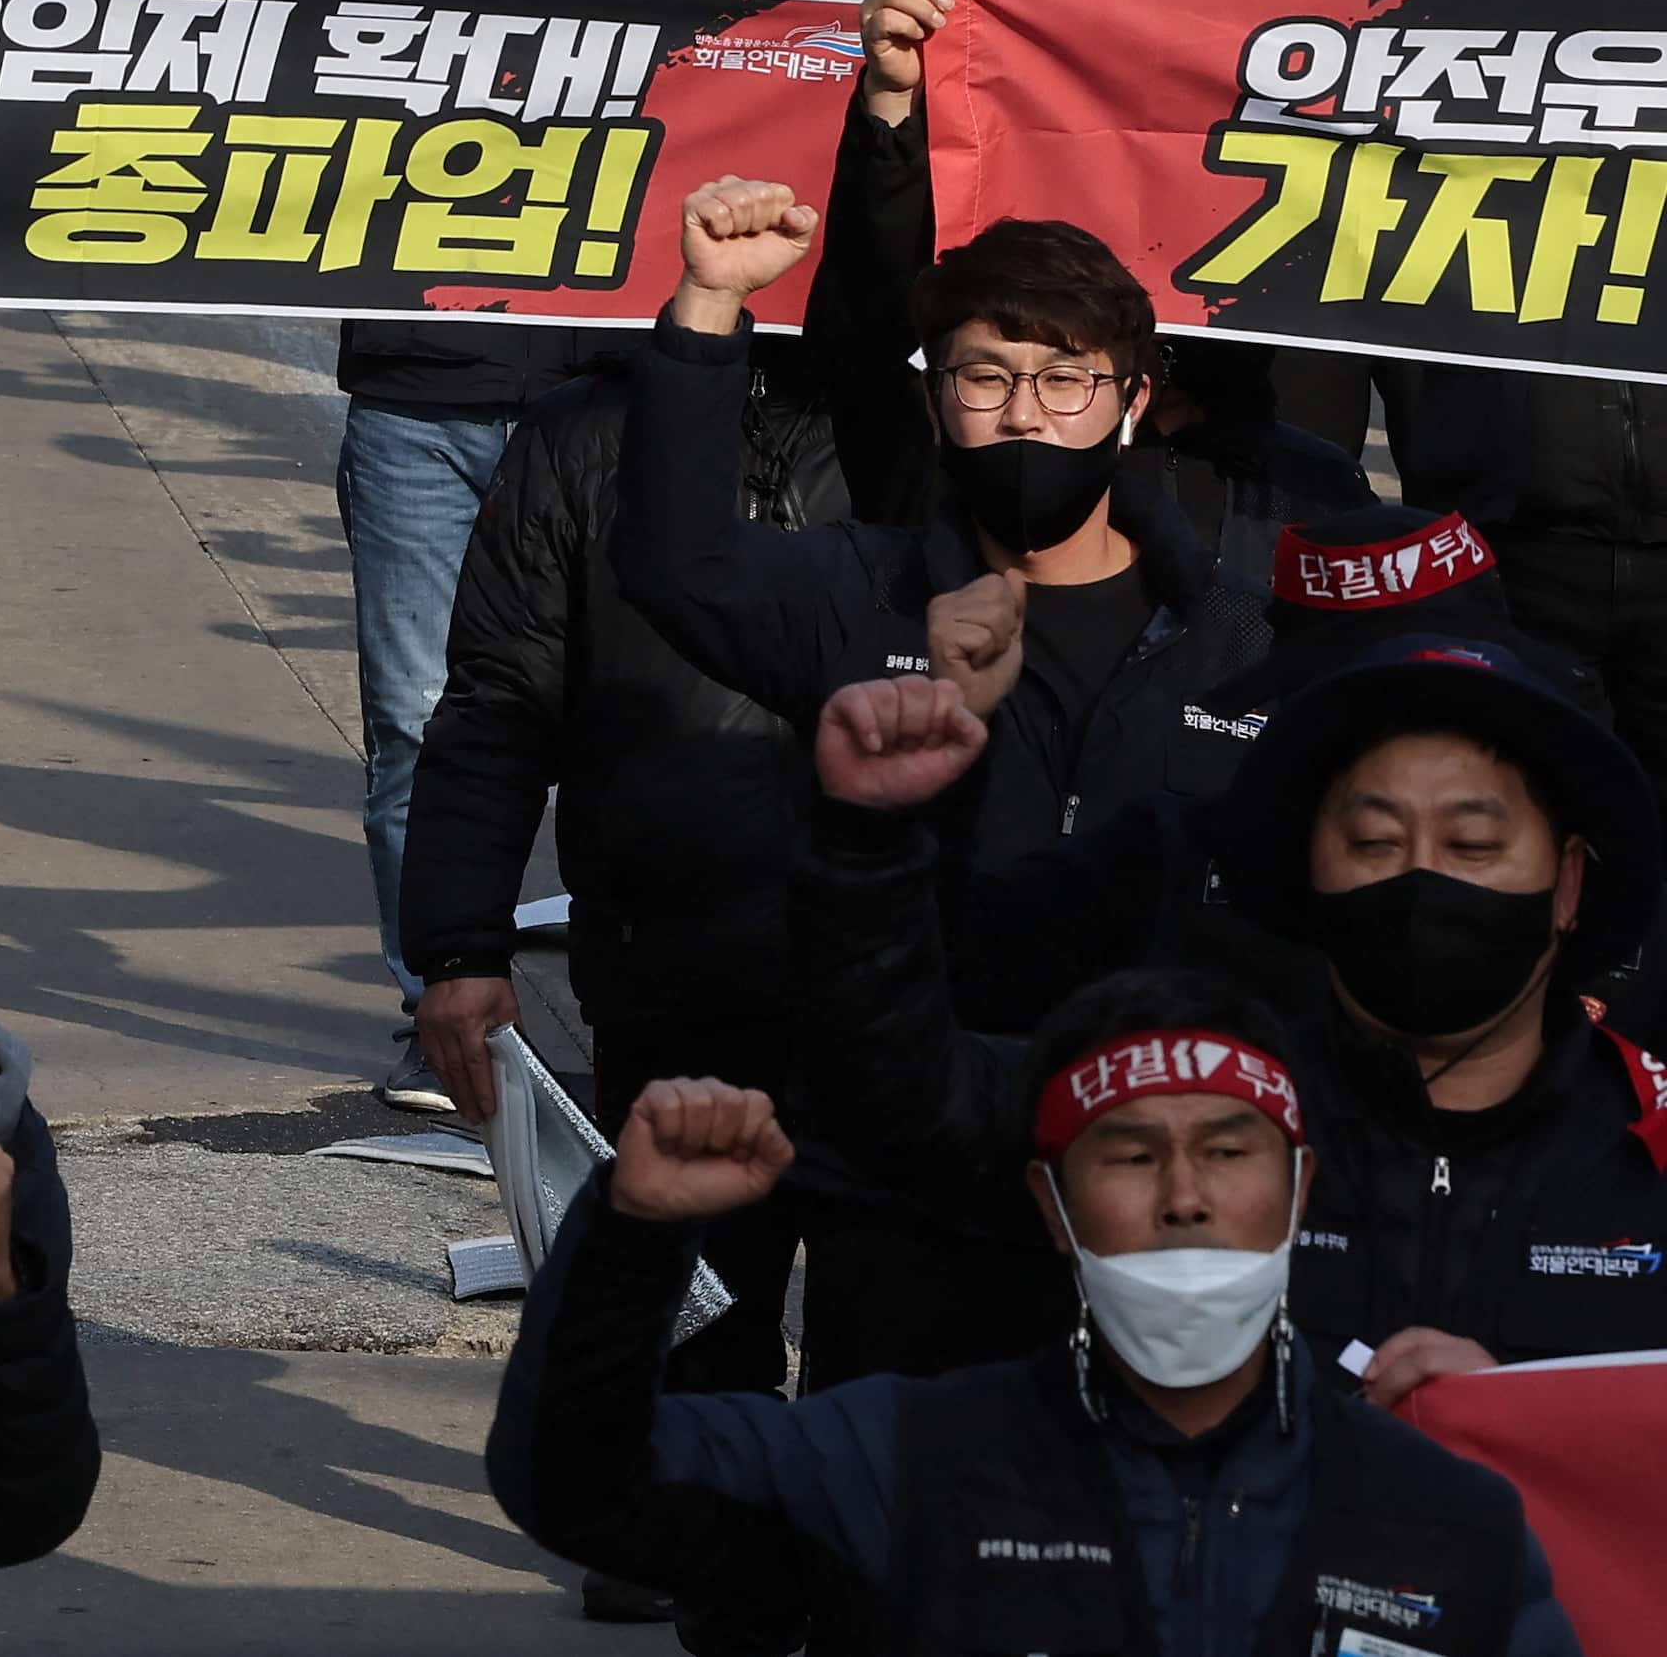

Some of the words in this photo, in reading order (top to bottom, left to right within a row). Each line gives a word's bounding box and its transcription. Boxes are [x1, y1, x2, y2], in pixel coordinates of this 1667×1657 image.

[315, 2, 660, 126] 확대!
[693, 46, 854, 82] 화물연대본부
[25, 103, 649, 279] 총파업!
[1189, 131, 1667, 325] 가자!
[1298, 547, 1377, 603] 단결
[1429, 518, 1486, 571] 투쟁
[1069, 1045, 1166, 1108] 단결
[1235, 1052, 1300, 1135] 투쟁
[1529, 1255, 1641, 1278] 화물연대본부
